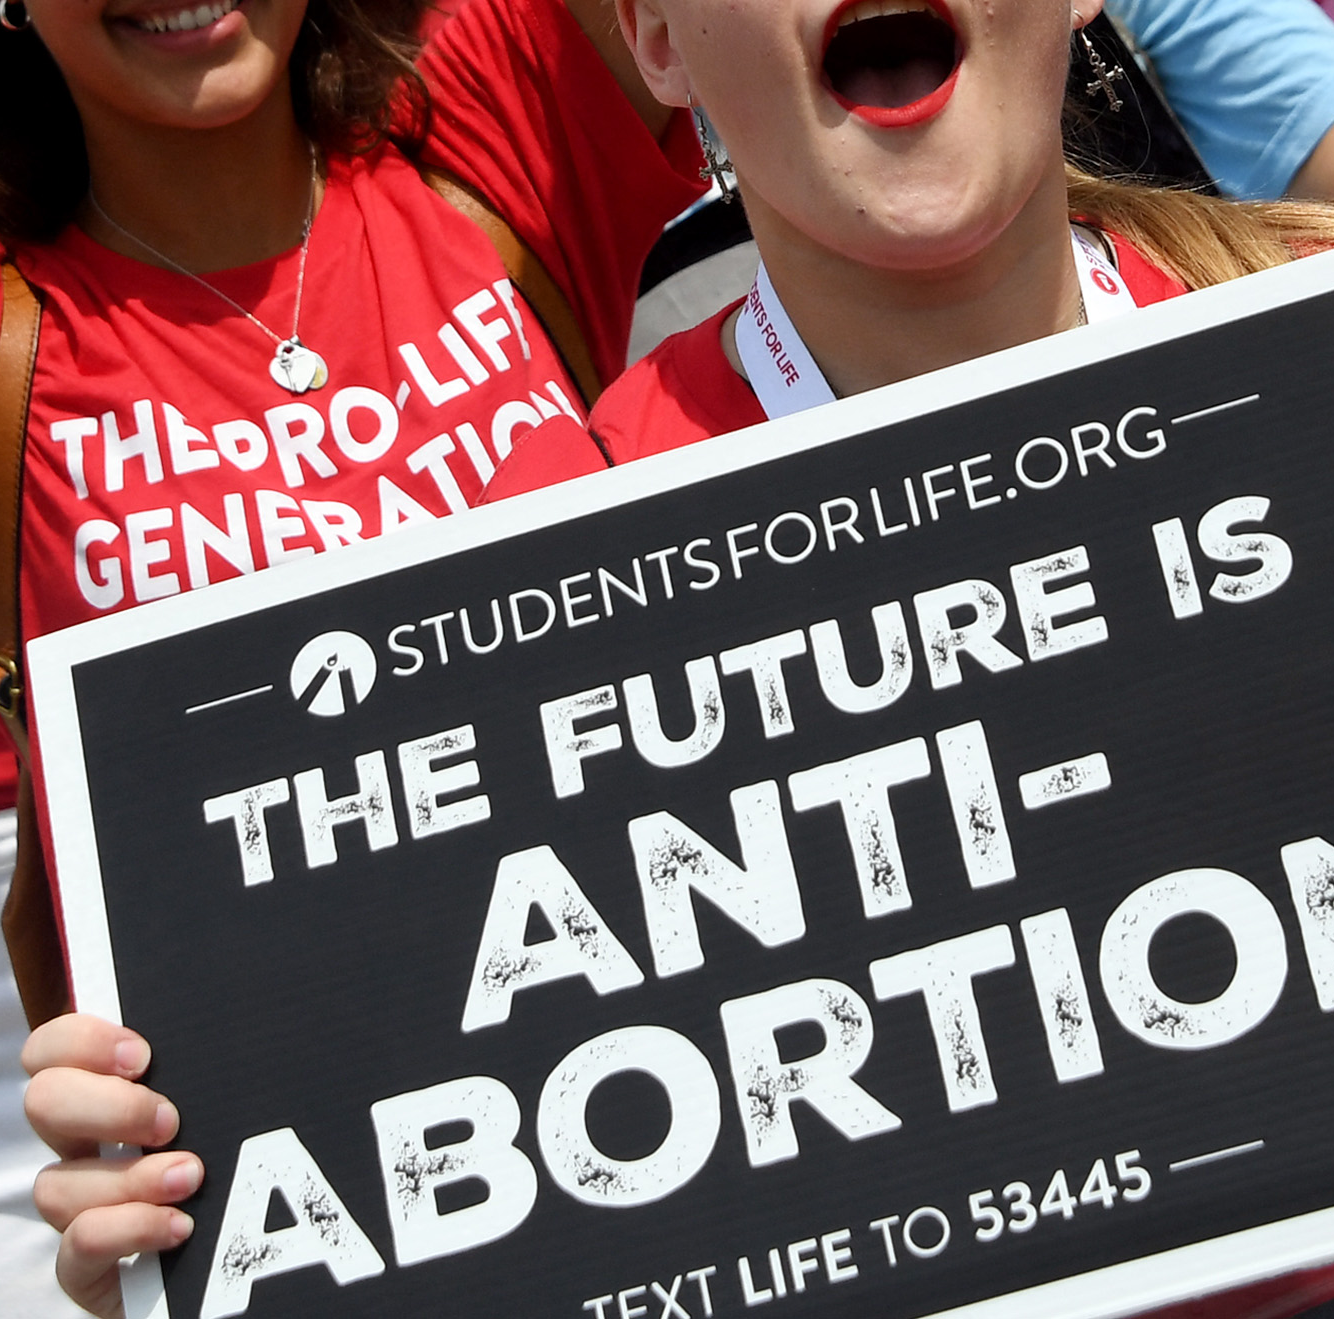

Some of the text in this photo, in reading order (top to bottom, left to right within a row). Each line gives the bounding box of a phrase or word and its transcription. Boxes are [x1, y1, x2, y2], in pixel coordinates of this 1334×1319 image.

[50, 399, 221, 500] THE
[761, 322, 783, 359] FOR
[775, 352, 801, 388] LIFE
[388, 407, 1166, 676] STUDENTSFORLIFE.ORG
[203, 496, 1293, 887] THE FUTURE IS
[464, 720, 1111, 1033] ANTI-
[738, 1229, 858, 1306] LIFE
[870, 1207, 950, 1266] TO
[969, 1150, 1151, 1241] 53445
